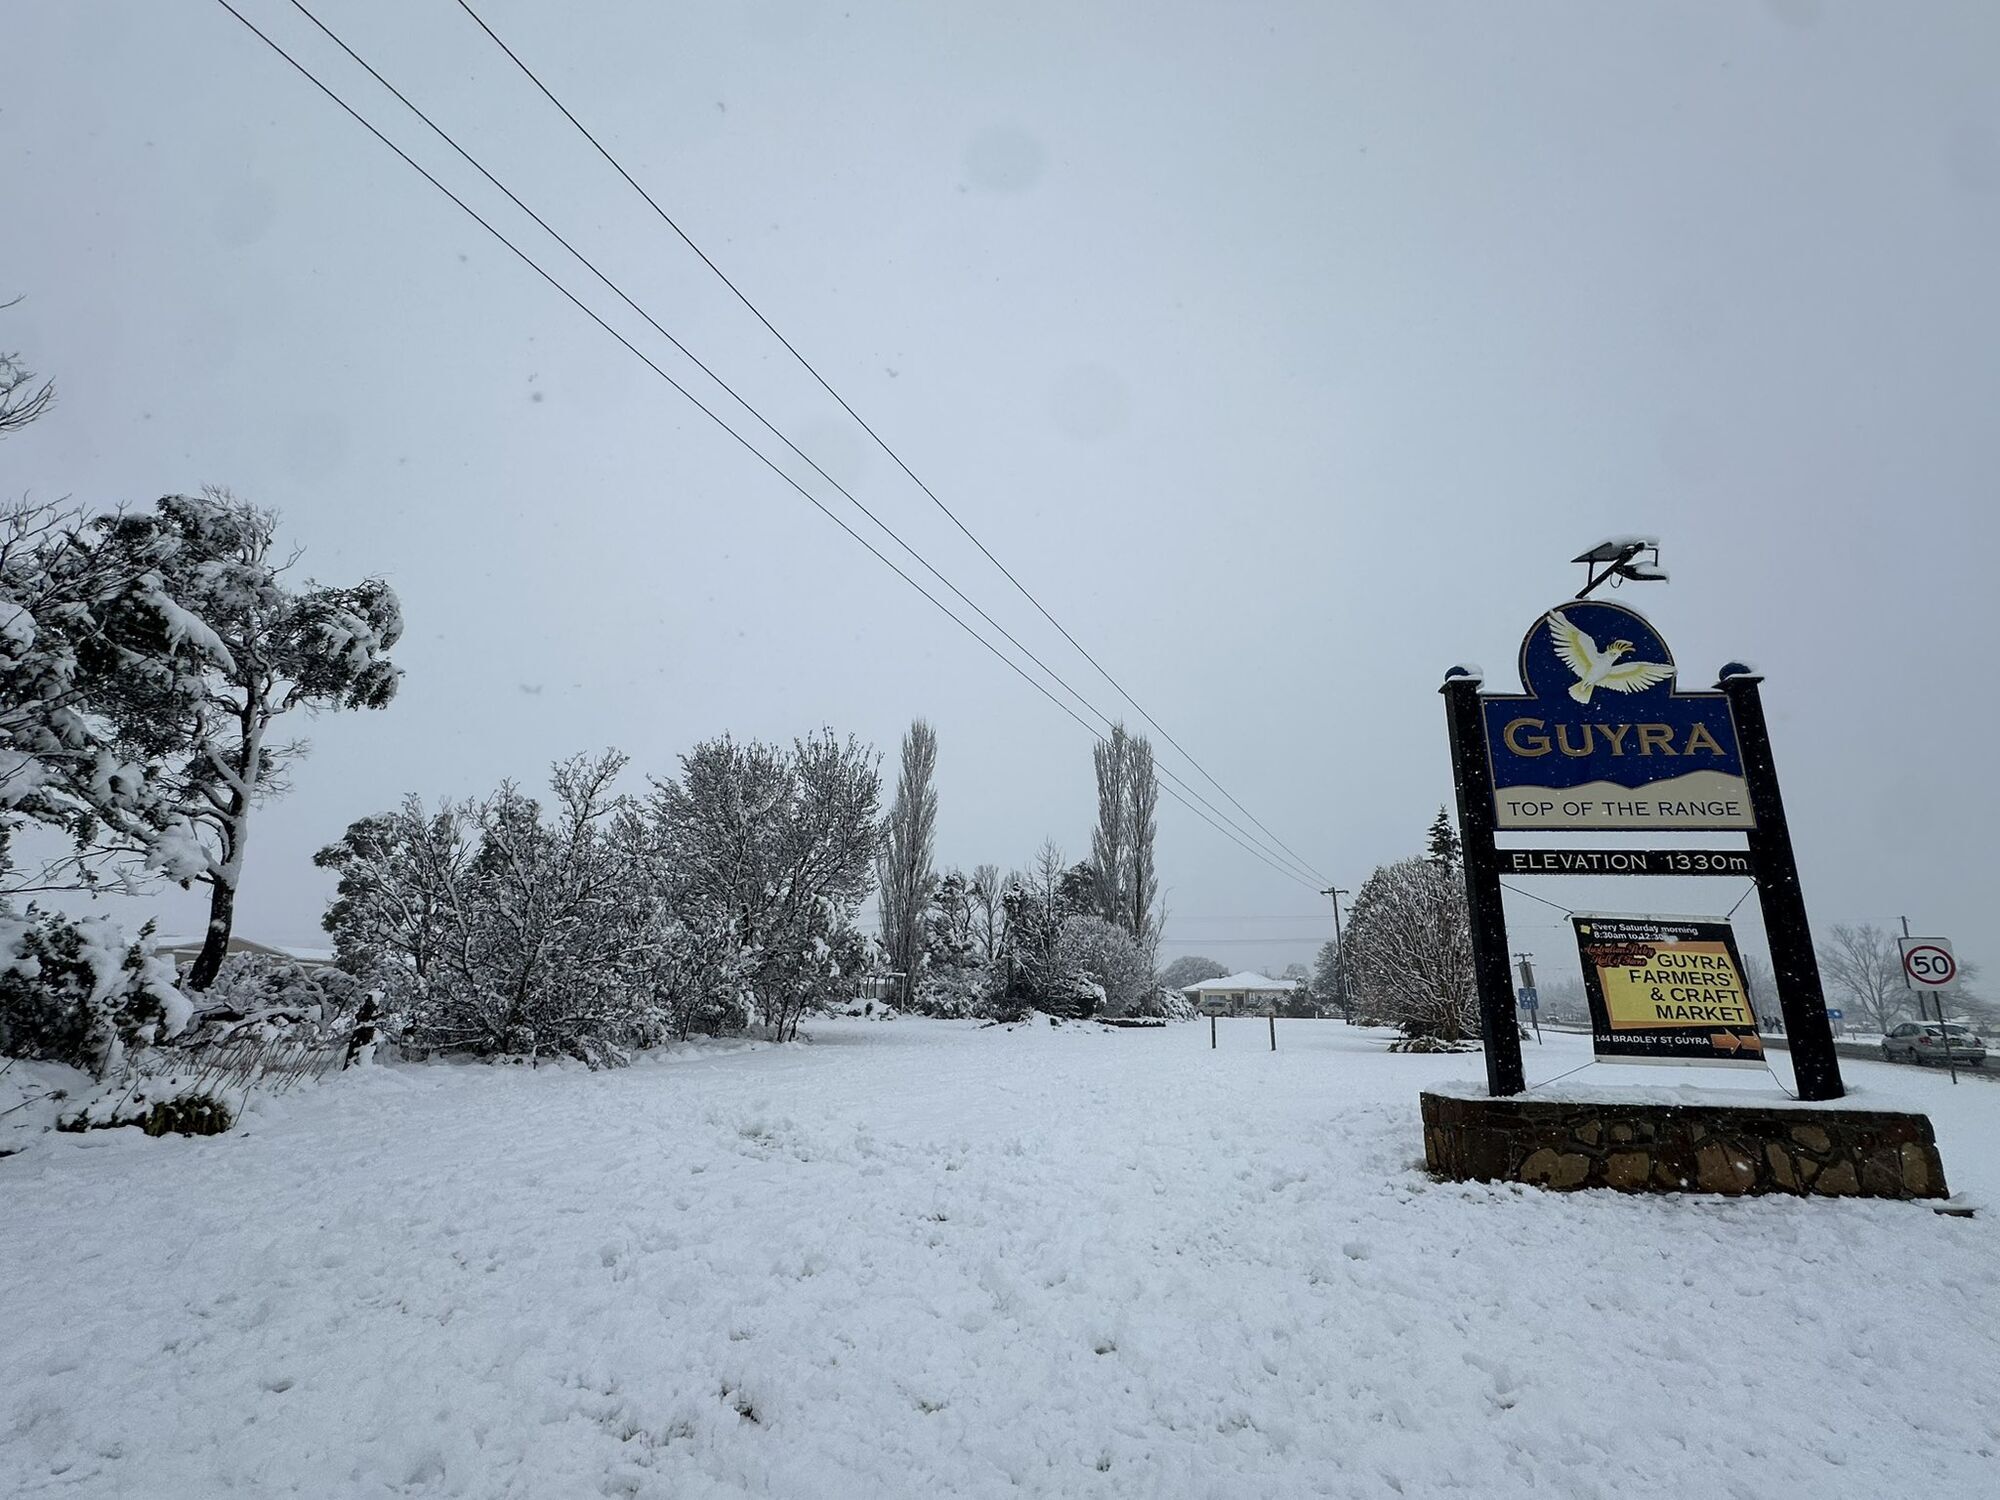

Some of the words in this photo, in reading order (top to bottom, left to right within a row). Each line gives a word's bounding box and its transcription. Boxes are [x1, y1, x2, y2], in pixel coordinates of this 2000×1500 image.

[1504, 718, 1727, 757] GUYRA
[1507, 801, 1554, 817] TOP
[1563, 801, 1593, 817] OF
[1602, 801, 1650, 817] THE
[1659, 801, 1741, 817] RANGE
[1512, 853, 1648, 870] ELEVATION
[1666, 854, 1748, 870] 1330m
[1592, 923, 1617, 932] Every
[1619, 923, 1659, 933] Saturday
[1661, 926, 1699, 935] morning
[1594, 931, 1627, 939] 8:30am
[1628, 932, 1637, 940] to
[1657, 953, 1730, 970] GUYRA
[1914, 956, 1948, 975] 50
[1629, 969, 1734, 987] FARMERS'
[1650, 987, 1665, 1002] &
[1670, 987, 1739, 1004] CRAFT
[1656, 1005, 1745, 1022] MARKET
[1595, 1034, 1611, 1042] 144
[1612, 1035, 1658, 1044] BRADLEY
[1660, 1036, 1673, 1044] ST
[1675, 1037, 1710, 1045] GUYRA
